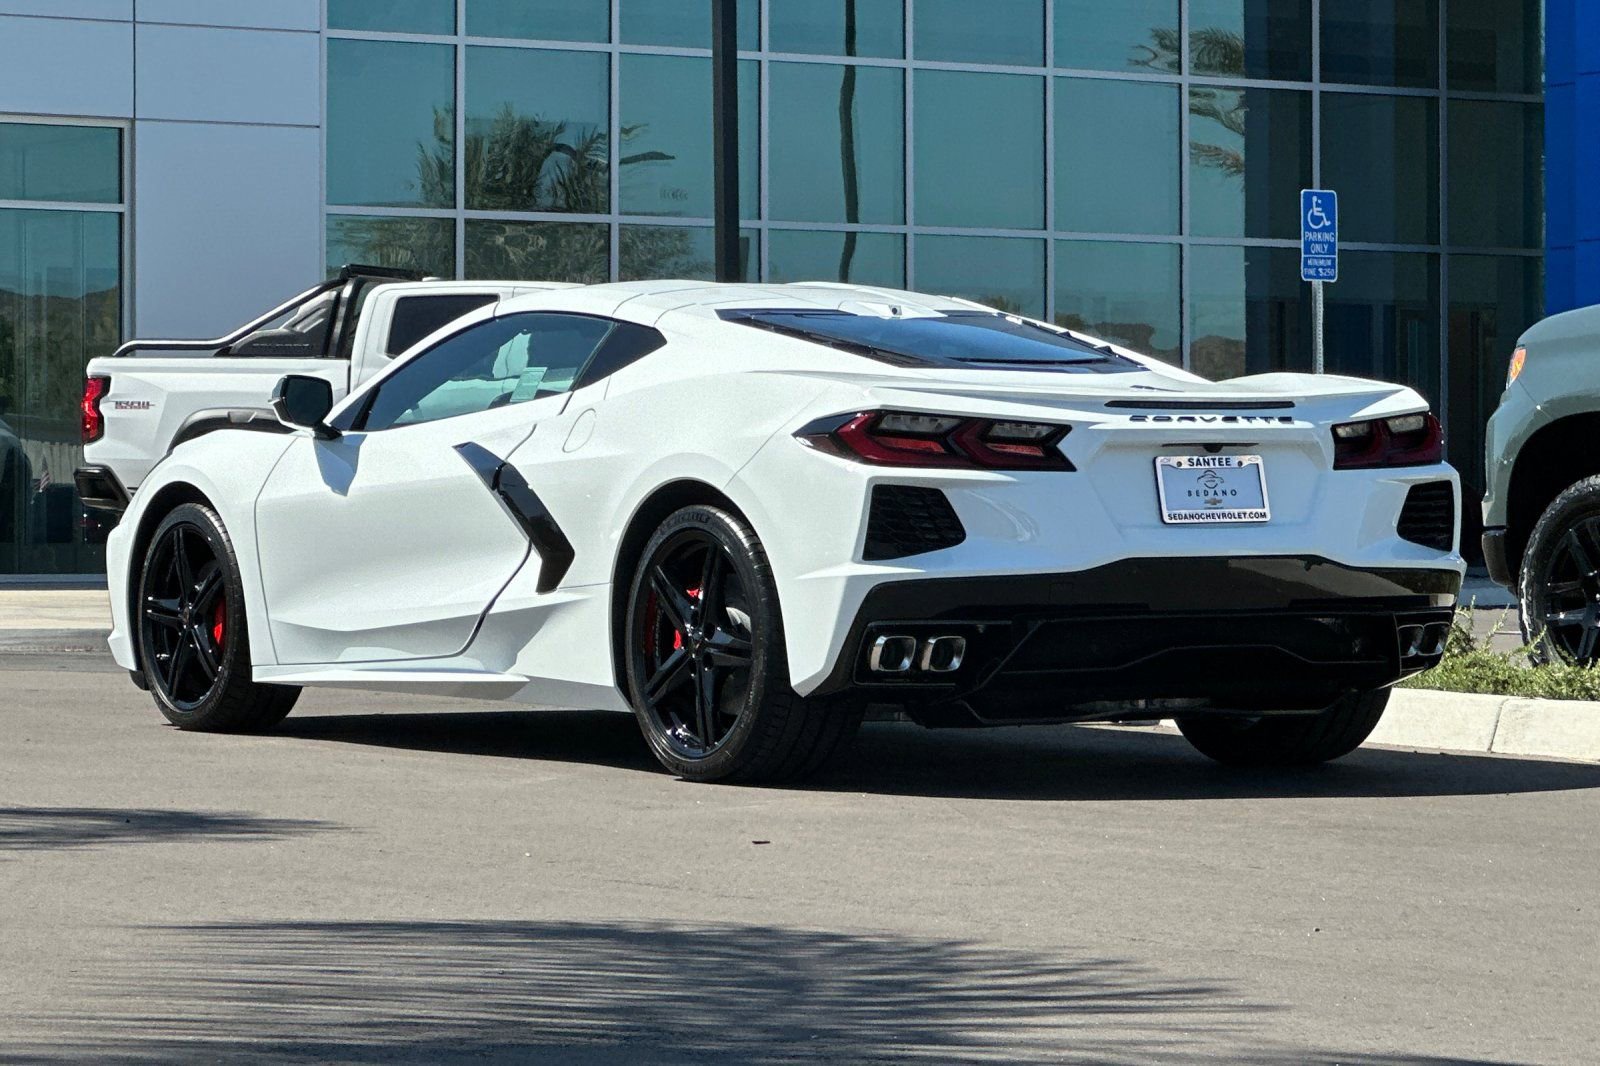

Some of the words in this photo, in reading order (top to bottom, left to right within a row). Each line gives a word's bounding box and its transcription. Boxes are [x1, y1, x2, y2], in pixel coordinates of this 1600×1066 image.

[1305, 232, 1334, 242] PARKING
[1310, 243, 1328, 254] ONLY
[1307, 258, 1332, 266] MINIMUM
[1304, 268, 1317, 276] FINE
[1318, 268, 1335, 277] $250
[1188, 457, 1231, 467] SANTEE
[1187, 489, 1237, 497] SEDANO
[1167, 511, 1267, 521] SEDANOCHEVROLET.COM
